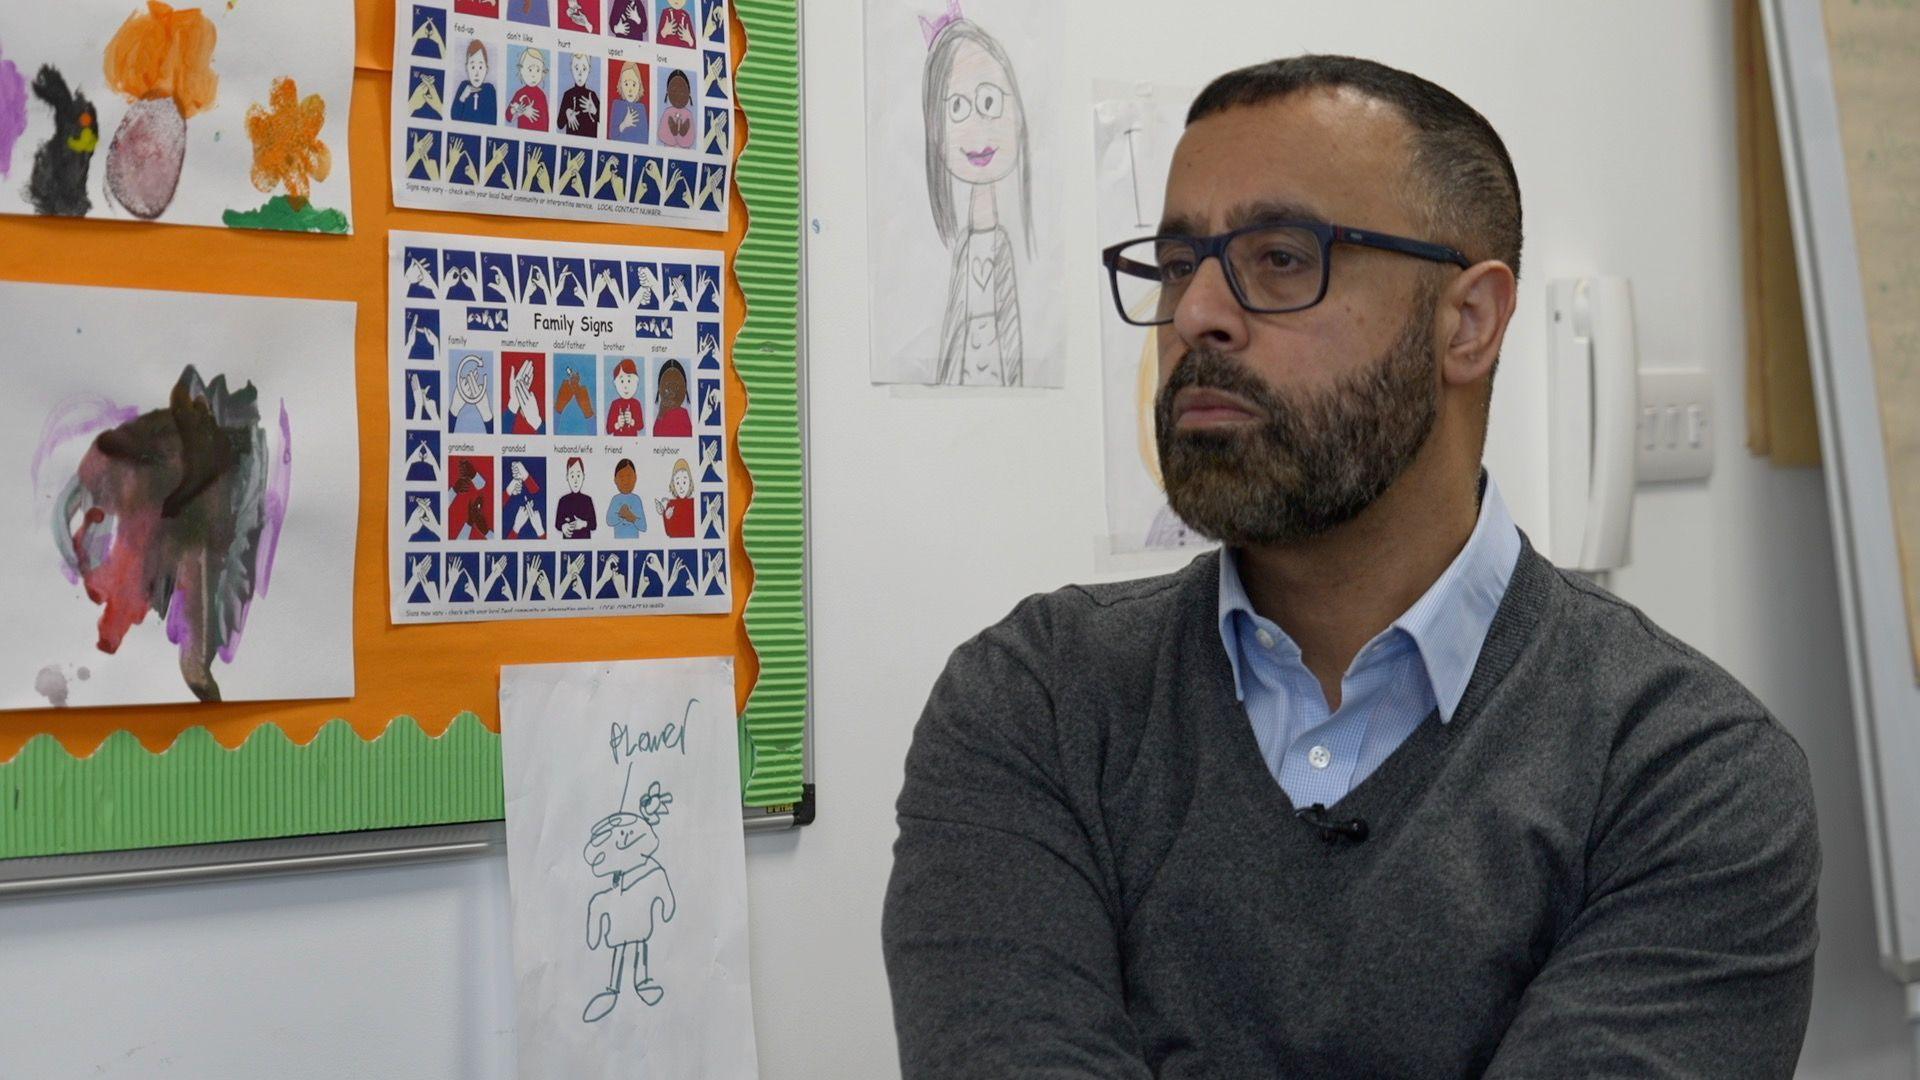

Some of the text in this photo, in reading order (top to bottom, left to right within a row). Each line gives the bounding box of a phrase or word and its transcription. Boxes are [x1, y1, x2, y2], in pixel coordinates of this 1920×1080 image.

[454, 23, 475, 35] fed-up
[522, 33, 534, 43] like
[557, 38, 571, 48] hurt
[656, 54, 668, 63] love
[597, 203, 613, 212] LOCAL
[615, 205, 639, 214] CONTACT
[534, 313, 613, 337] Family Signs
[448, 335, 467, 346] family
[501, 338, 539, 348] mum/mother
[553, 340, 586, 350] dad/father
[603, 341, 625, 351] brother
[651, 344, 668, 352] sister
[448, 443, 475, 453] grandma
[501, 443, 526, 454] grandad
[554, 444, 593, 454] husband/wife
[604, 444, 623, 454] friend
[653, 445, 680, 456] neighbour
